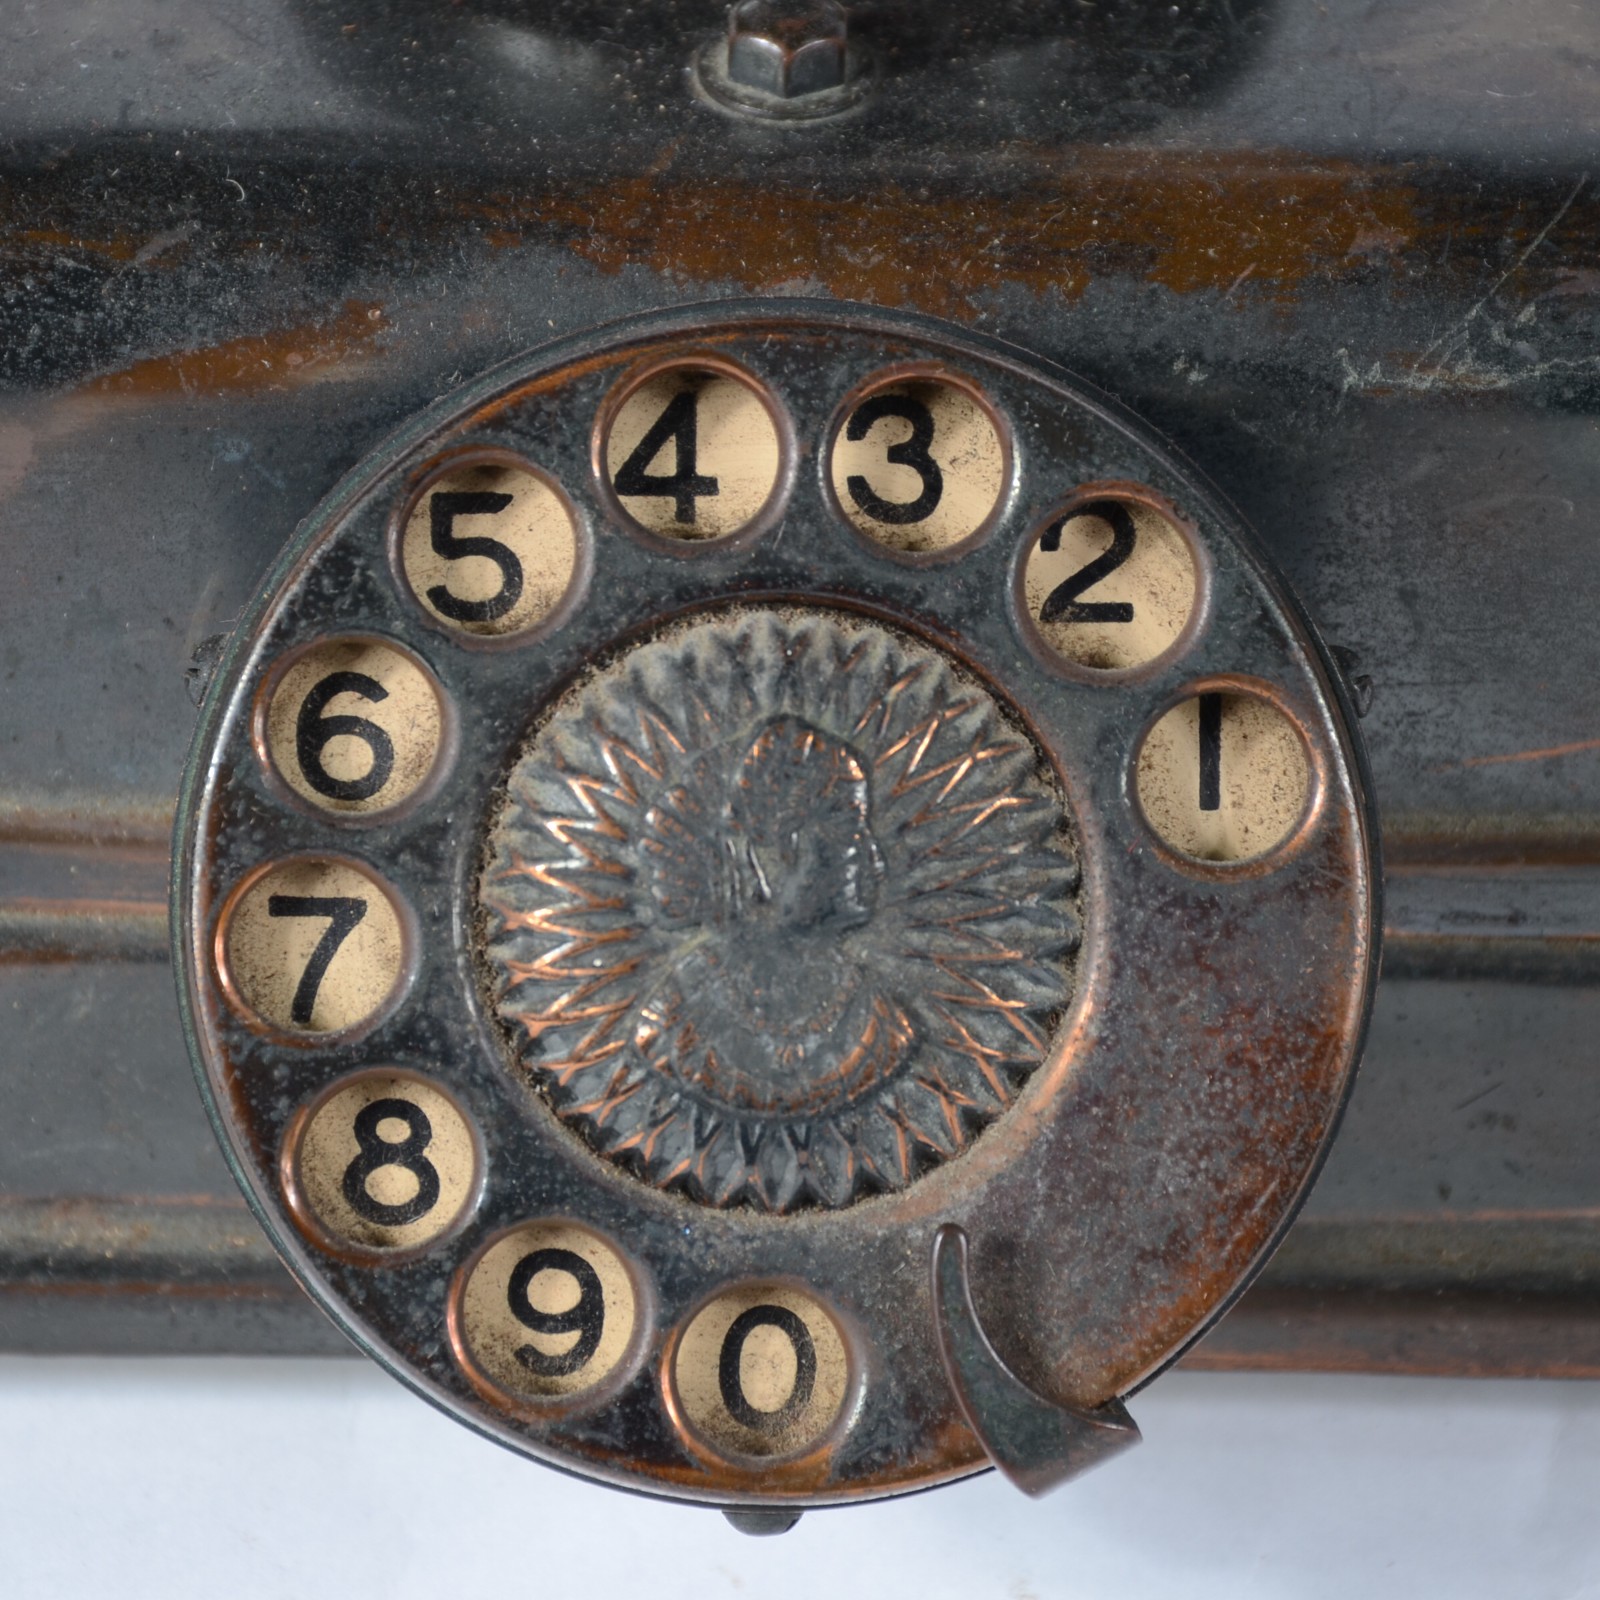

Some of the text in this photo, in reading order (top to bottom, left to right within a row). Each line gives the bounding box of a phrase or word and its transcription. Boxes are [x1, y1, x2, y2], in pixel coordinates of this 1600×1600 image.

[612, 390, 719, 524] 4
[847, 396, 943, 525] 3
[427, 491, 523, 621] 5
[1039, 502, 1135, 623] 2
[296, 670, 394, 800] 6
[1197, 693, 1222, 811] 1
[268, 895, 366, 1023] 7
[341, 1098, 440, 1226] 8
[507, 1248, 604, 1377] 9
[719, 1305, 817, 1430] 0
